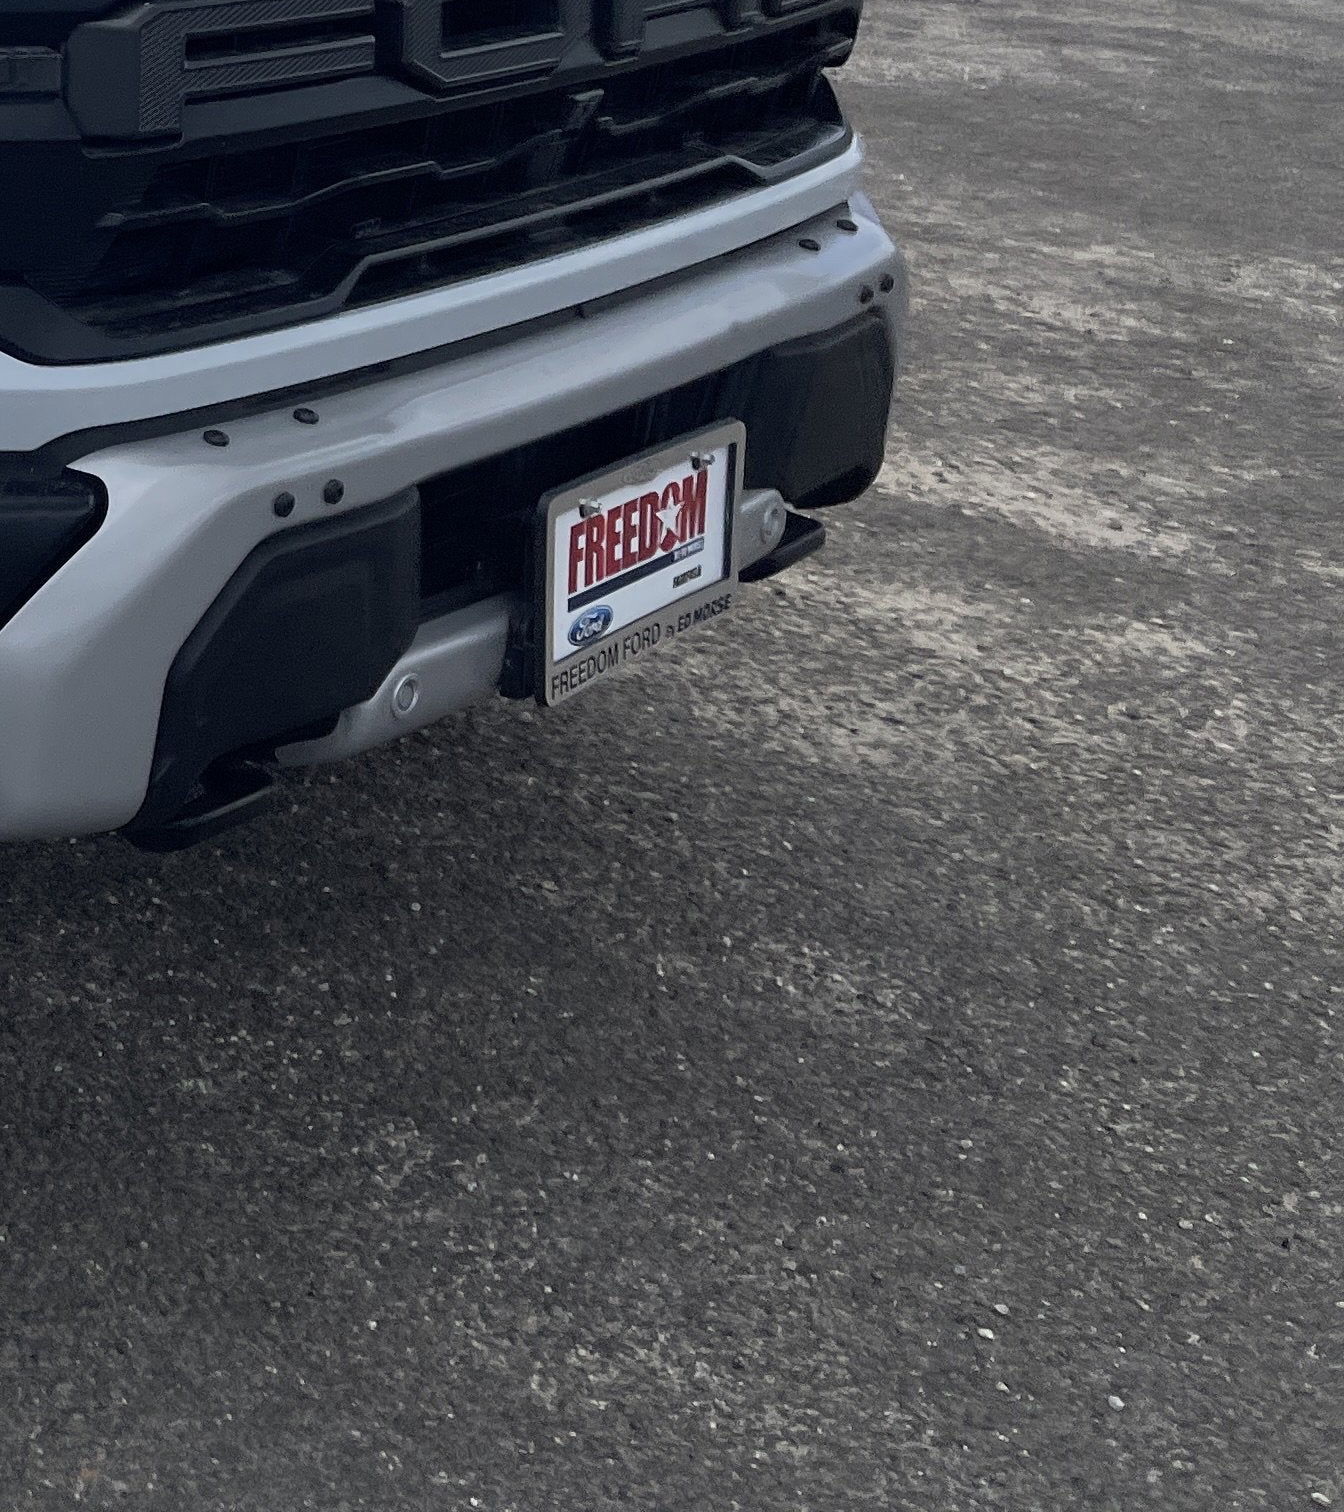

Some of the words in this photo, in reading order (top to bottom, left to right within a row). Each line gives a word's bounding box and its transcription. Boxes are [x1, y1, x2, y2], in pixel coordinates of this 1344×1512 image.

[568, 468, 708, 594] FREEDOM
[551, 643, 619, 701] FREEDOM
[623, 623, 661, 661] FORD
